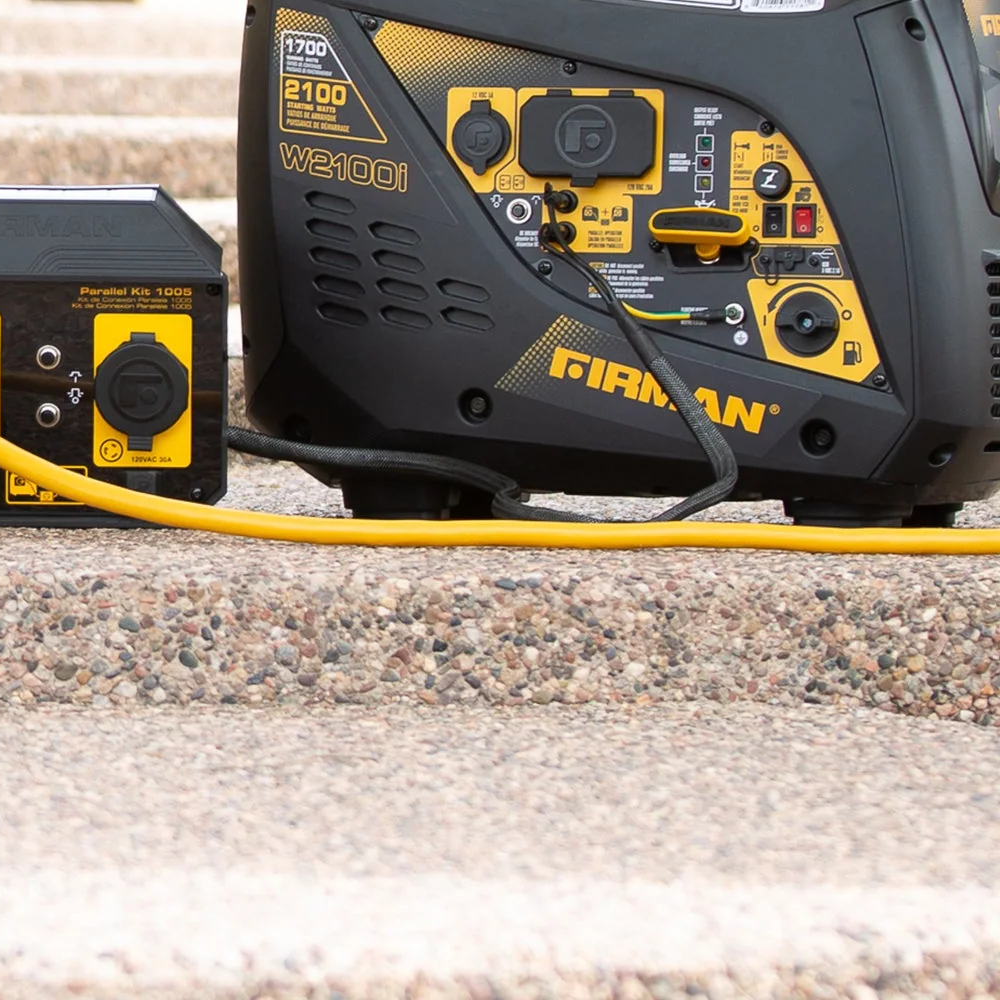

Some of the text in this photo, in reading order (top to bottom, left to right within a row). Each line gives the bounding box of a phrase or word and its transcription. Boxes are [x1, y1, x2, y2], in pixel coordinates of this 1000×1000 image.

[285, 38, 327, 57] 1700
[284, 79, 347, 106] 2100
[279, 142, 408, 193] W2100i
[80, 286, 127, 296] Parallel
[131, 287, 152, 296] Kit
